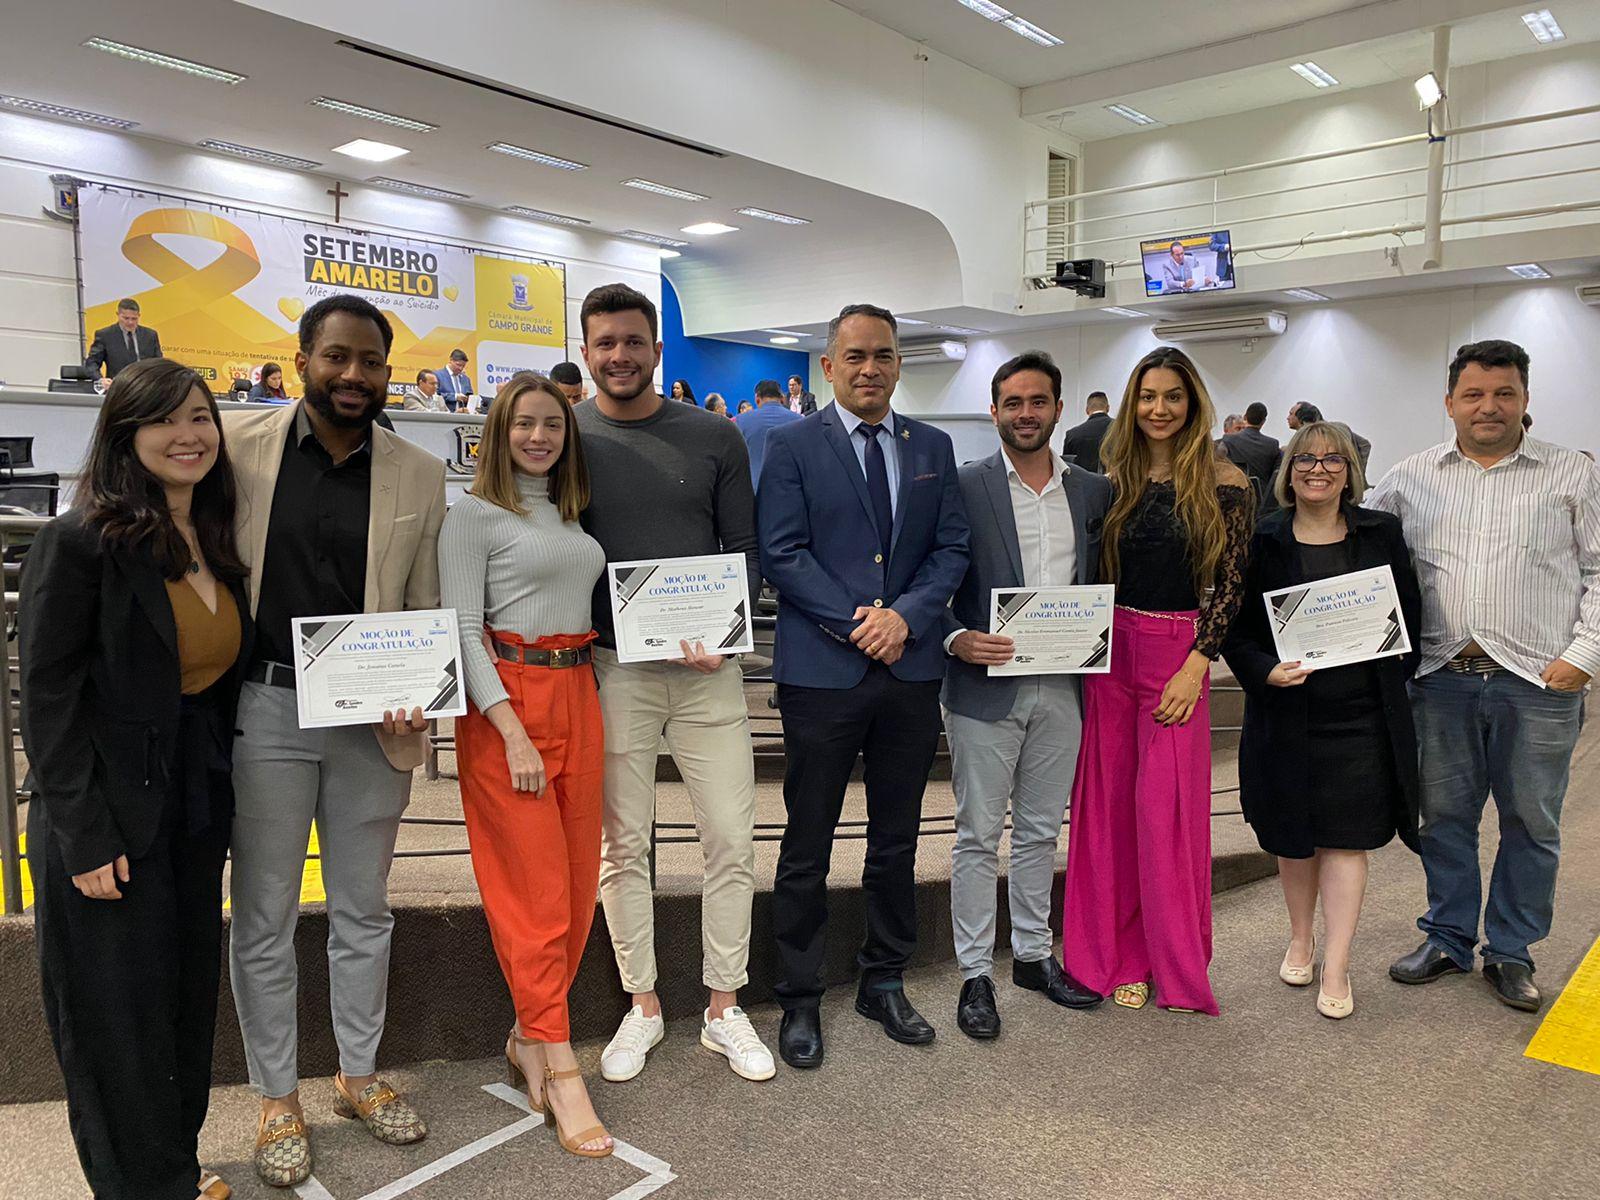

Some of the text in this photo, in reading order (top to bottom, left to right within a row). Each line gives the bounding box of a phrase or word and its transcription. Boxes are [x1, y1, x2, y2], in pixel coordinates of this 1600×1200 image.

[303, 233, 438, 274] SETEMBRO
[310, 259, 433, 297] AMARELO
[305, 284, 328, 298] Mês
[407, 296, 439, 311] Suicídio
[488, 318, 553, 336] CAMPO GRANDE
[212, 350, 239, 360] situação
[240, 351, 249, 359] de
[249, 352, 279, 362] tentativa
[664, 573, 708, 585] MOÇÃO DE
[649, 582, 725, 596] CONGRATULAÇÃO
[1316, 589, 1358, 604] MOÇÃO DE
[1040, 601, 1069, 610] MOÇÃO
[1304, 595, 1376, 616] CONGRATULAÇÃO
[1025, 610, 1094, 619] CONGRATULAÇÃO
[360, 629, 414, 641] MOÇÃO DE
[341, 638, 433, 652] CONGRATULAÇÃO
